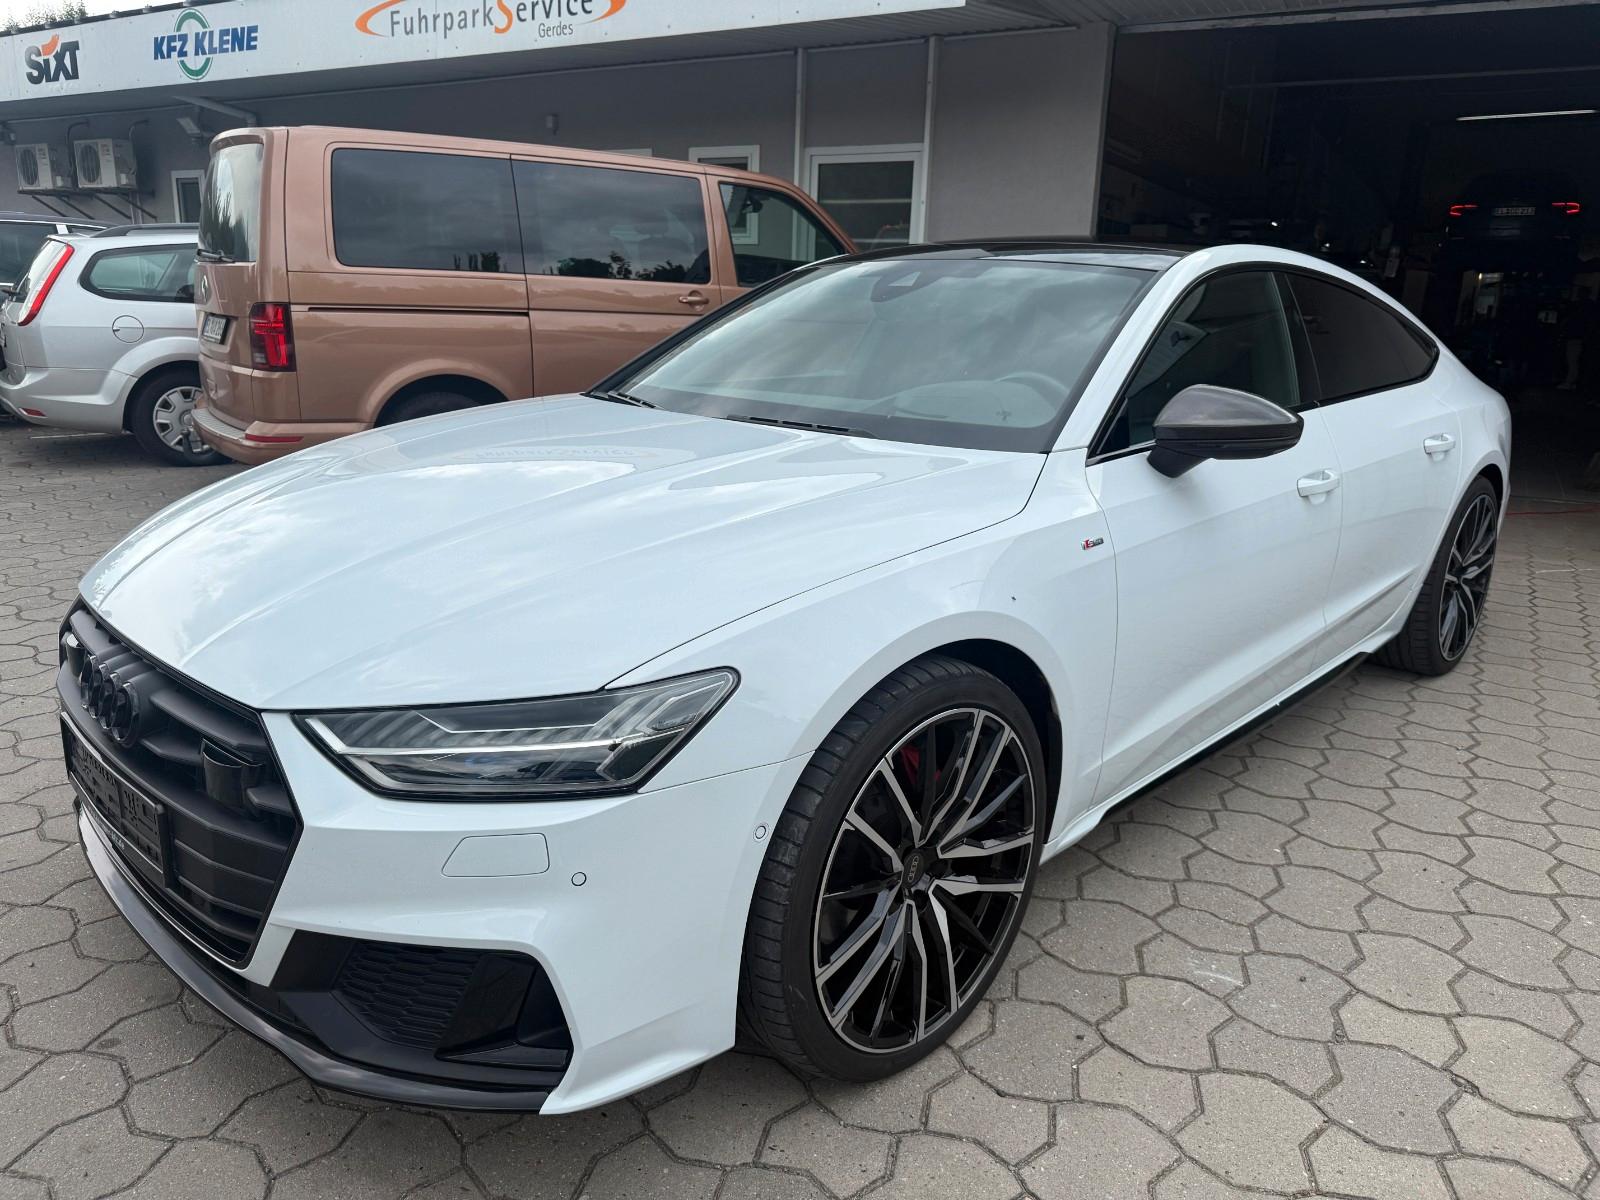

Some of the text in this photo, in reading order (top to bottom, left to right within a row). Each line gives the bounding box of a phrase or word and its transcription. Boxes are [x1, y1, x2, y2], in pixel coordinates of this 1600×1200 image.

[153, 25, 258, 60] KFZ KLENE
[538, 21, 574, 38] Gerdes
